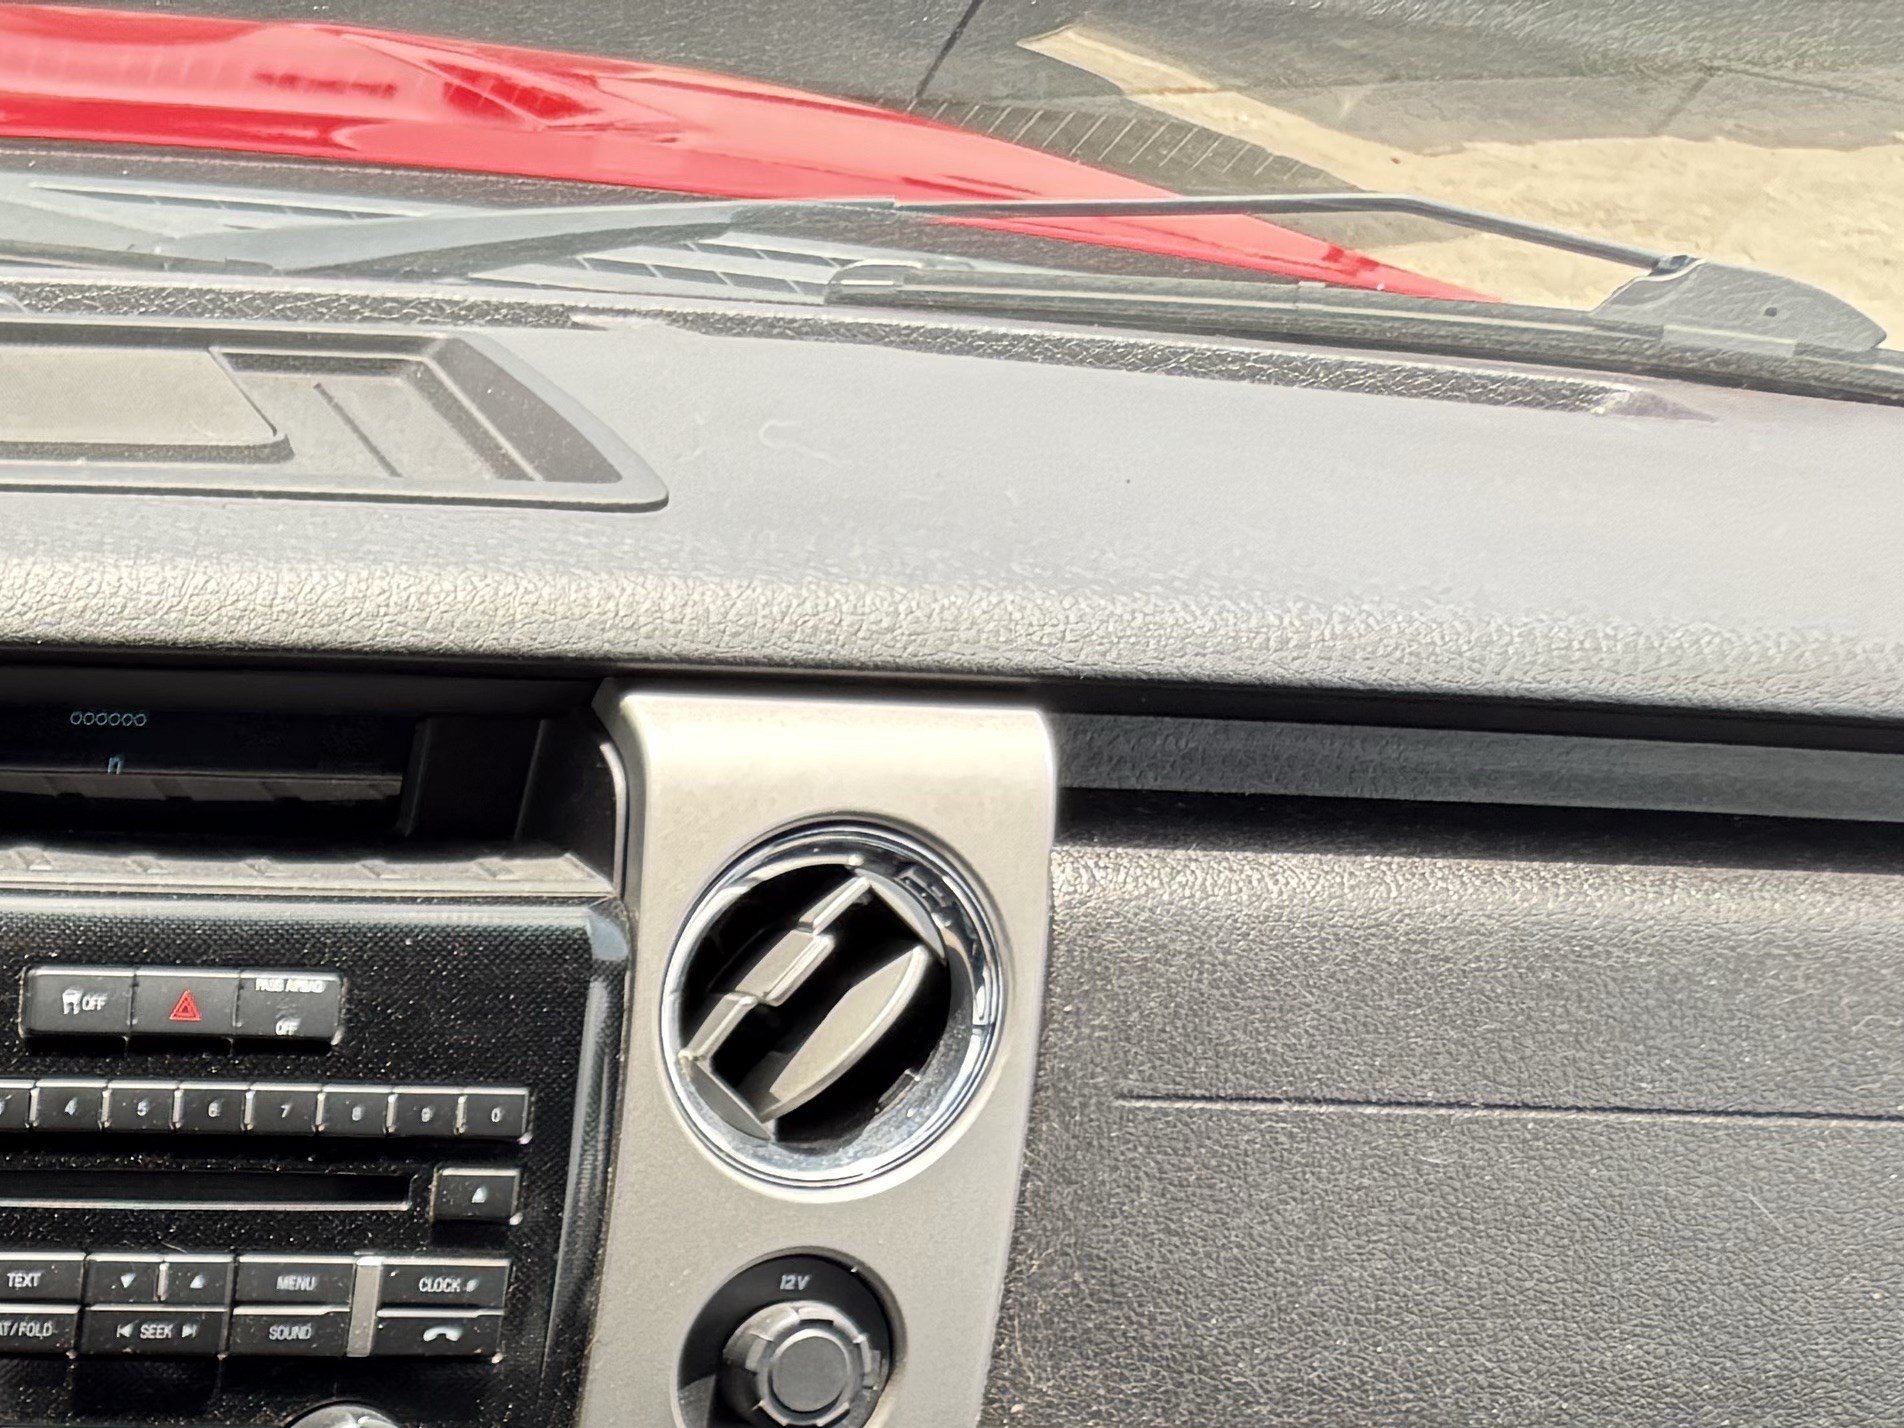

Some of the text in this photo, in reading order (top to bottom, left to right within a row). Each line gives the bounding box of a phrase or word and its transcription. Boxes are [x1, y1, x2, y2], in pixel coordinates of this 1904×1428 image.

[82, 994, 108, 1012] OFF
[276, 1018, 300, 1036] OFF
[64, 1099, 77, 1116] 4
[136, 1100, 149, 1117] 5
[281, 1104, 292, 1119] 7
[7, 1271, 41, 1288] TEXT
[277, 1275, 317, 1291] MENU
[419, 1276, 461, 1293] CLOCK
[779, 1273, 810, 1291] 12V
[141, 1323, 173, 1339] SEEK
[269, 1323, 312, 1340] SOUND
